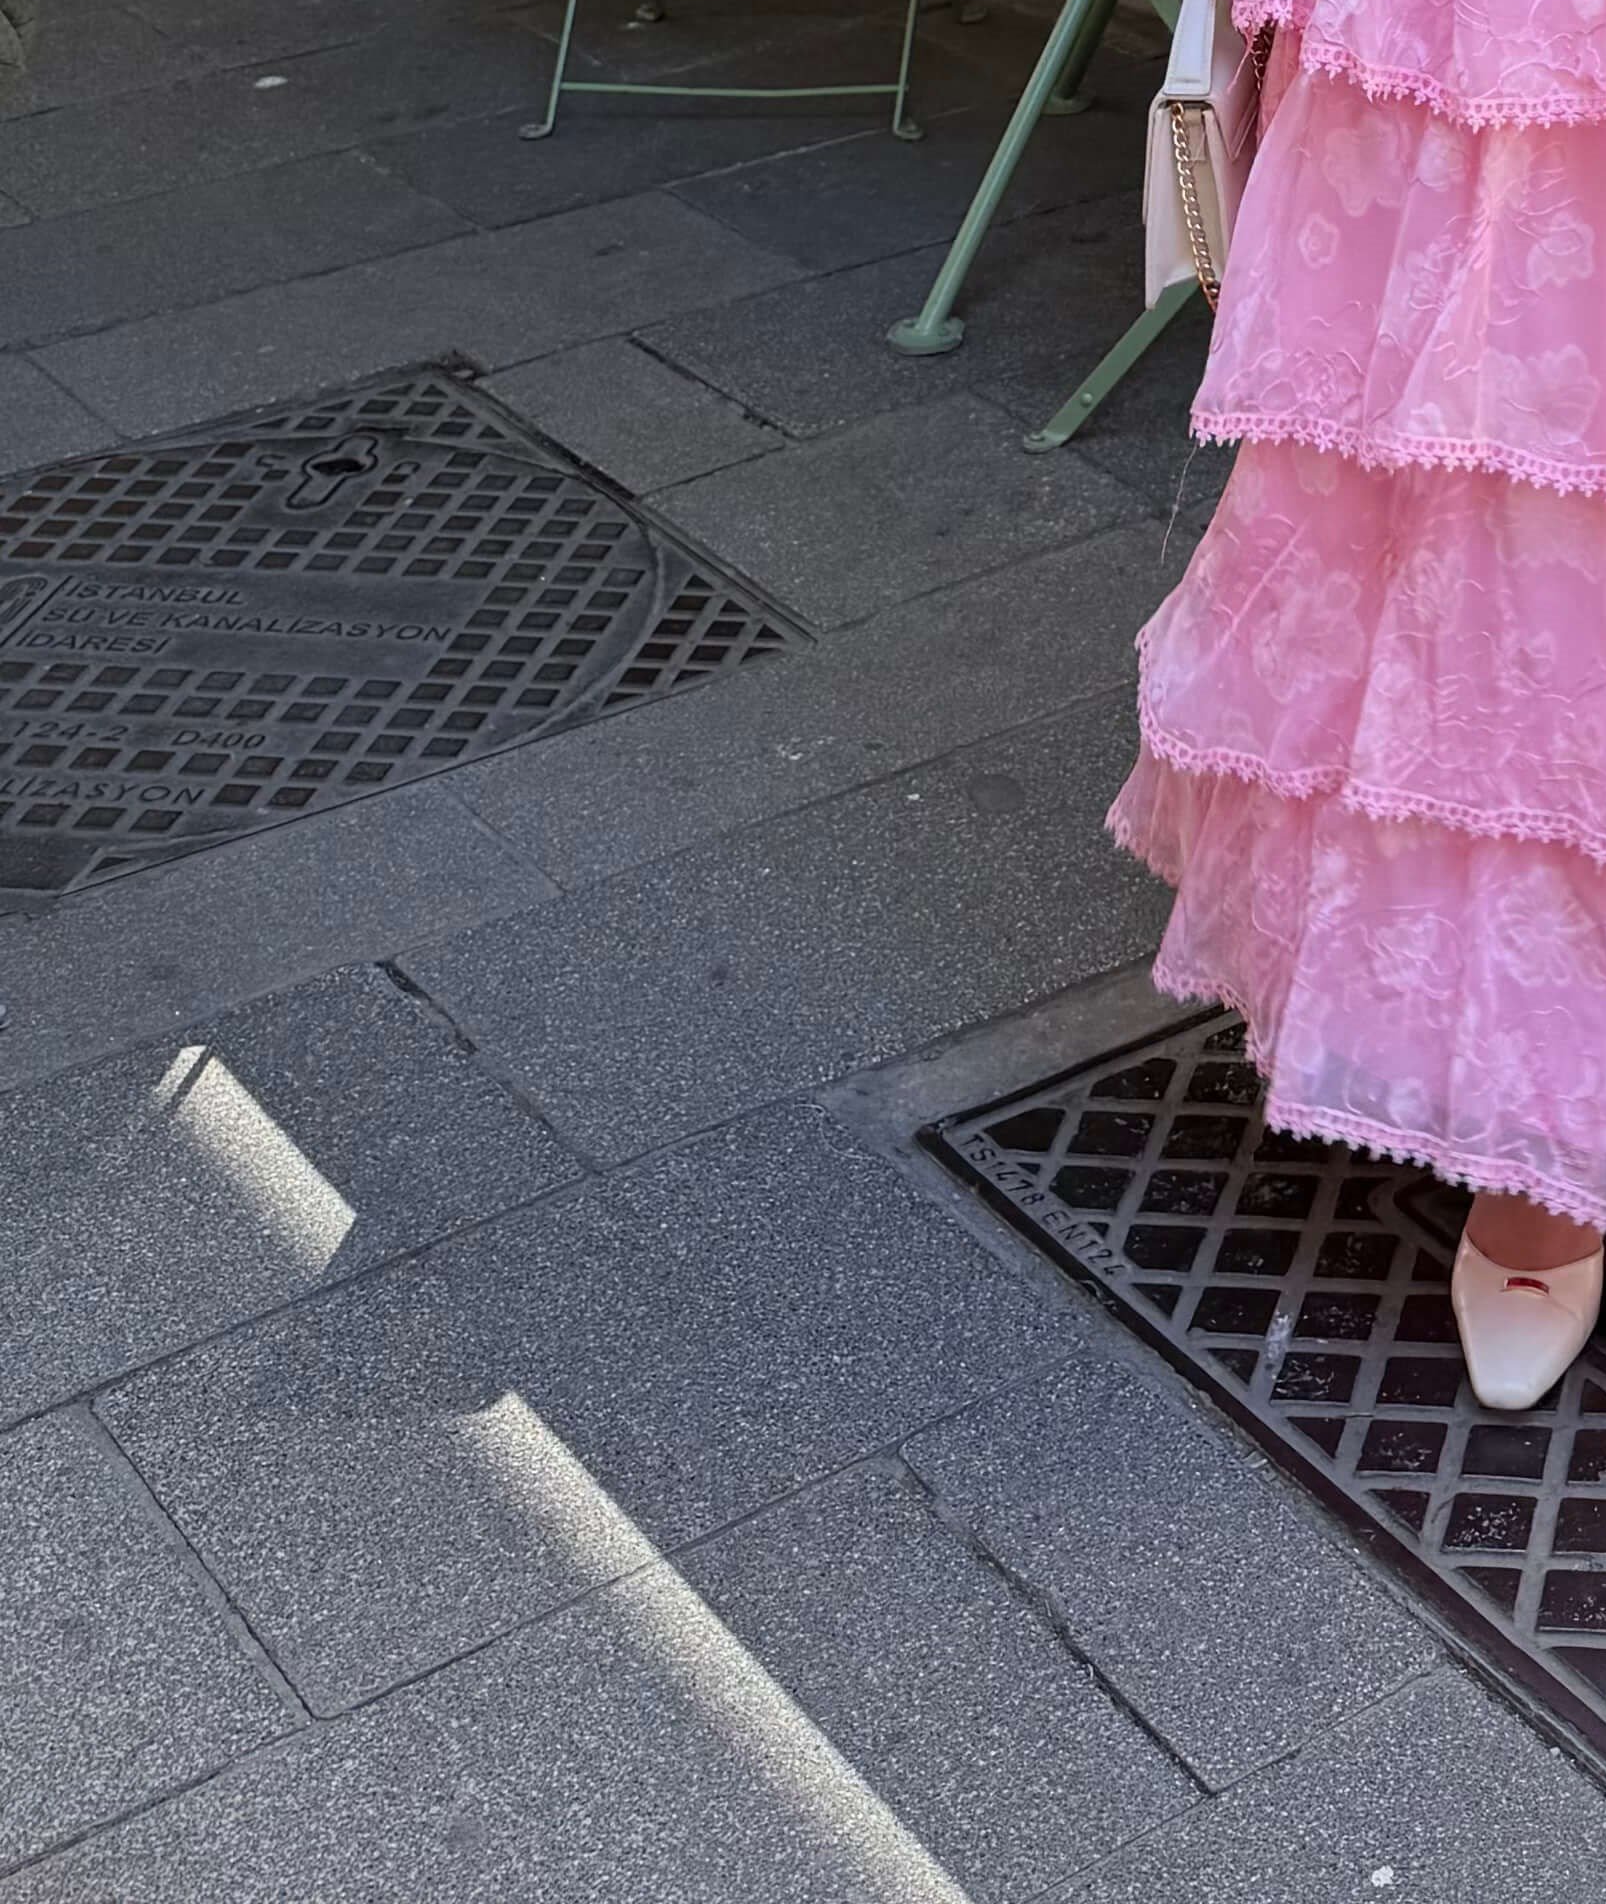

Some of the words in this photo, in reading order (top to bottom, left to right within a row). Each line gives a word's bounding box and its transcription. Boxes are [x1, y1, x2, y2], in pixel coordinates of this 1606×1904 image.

[42, 608, 95, 623] SU
[106, 611, 152, 627] VE
[13, 720, 128, 742] 124-2
[171, 730, 266, 749] D400
[1041, 1210, 1126, 1275] EN124
